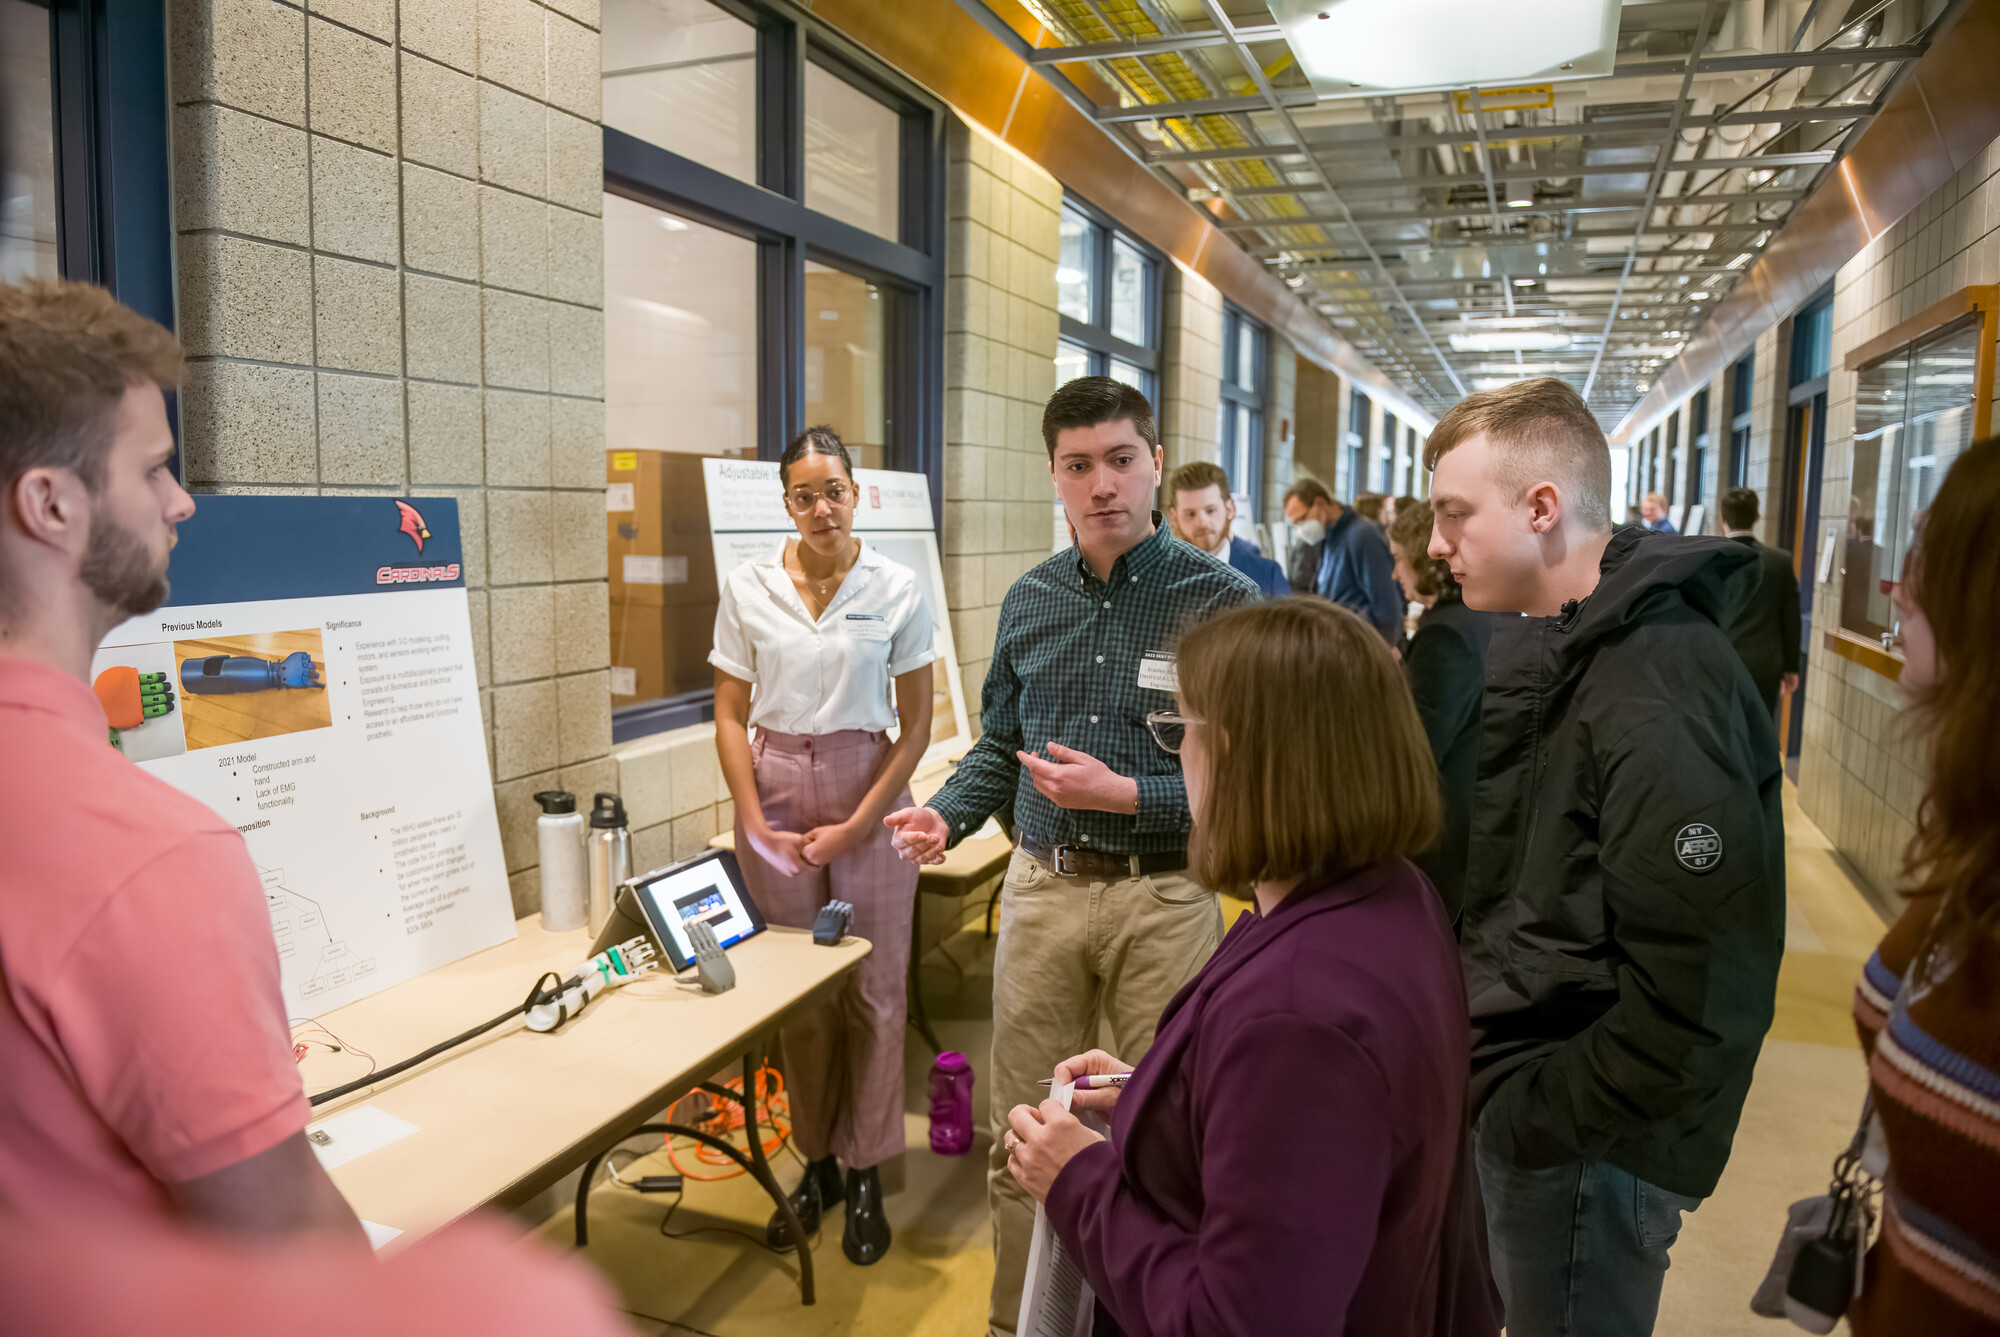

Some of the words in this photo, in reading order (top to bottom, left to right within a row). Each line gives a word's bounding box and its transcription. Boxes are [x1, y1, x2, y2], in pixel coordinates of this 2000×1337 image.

[720, 464, 769, 481] Adjustable
[376, 564, 460, 584] CARDINALS
[162, 622, 194, 632] Previous
[196, 619, 222, 629] Models
[326, 620, 362, 630] Significance
[356, 640, 386, 650] Experience
[379, 650, 388, 658] and
[390, 650, 410, 658] sensors
[411, 648, 430, 656] working
[358, 664, 378, 674] system
[360, 675, 384, 684] Exposure
[361, 686, 382, 696] consists
[362, 696, 394, 707] Engineering
[364, 708, 389, 718] Research
[366, 720, 384, 729] access
[400, 714, 424, 724] affordable
[426, 711, 434, 719] and
[367, 730, 392, 742] prosthetic
[218, 756, 234, 768] 2021
[236, 752, 256, 764] Model
[252, 760, 290, 774] Constructed
[291, 758, 304, 766] arm
[304, 754, 316, 764] and
[254, 776, 270, 786] hand
[256, 788, 271, 798] Lack
[272, 786, 279, 794] of
[280, 782, 296, 793] EMG
[257, 796, 295, 810] functionality
[360, 806, 396, 820] Background
[402, 822, 416, 833] WHO
[1688, 827, 1702, 836] NY
[1680, 838, 1718, 855] AERO
[1694, 858, 1708, 866] 87
[403, 901, 424, 914] Average
